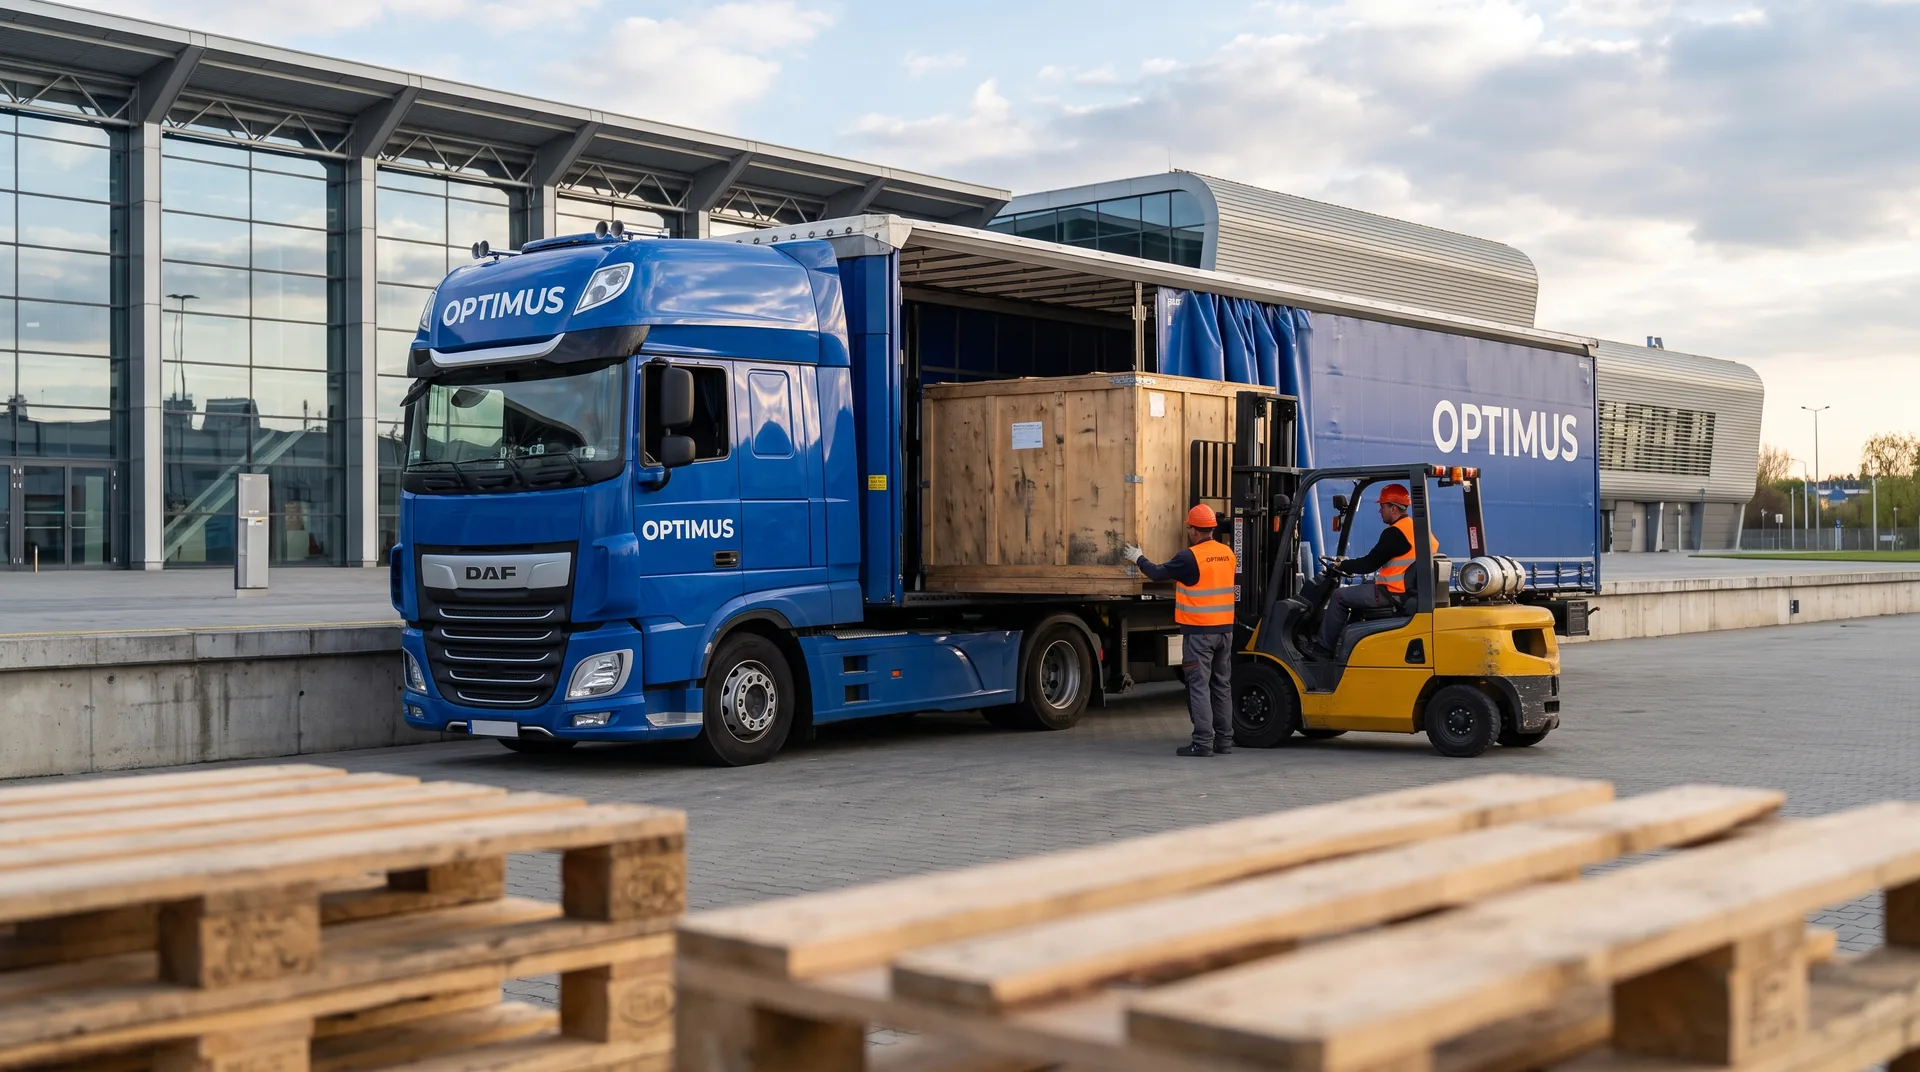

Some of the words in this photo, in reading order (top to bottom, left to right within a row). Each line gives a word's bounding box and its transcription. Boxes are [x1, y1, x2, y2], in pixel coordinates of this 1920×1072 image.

[443, 286, 565, 327] OPTIMUS
[1432, 399, 1578, 462] OPTIMUS
[642, 518, 734, 541] OPTIMUS
[1205, 555, 1230, 563] OPTIMUS
[466, 566, 516, 580] DAF
